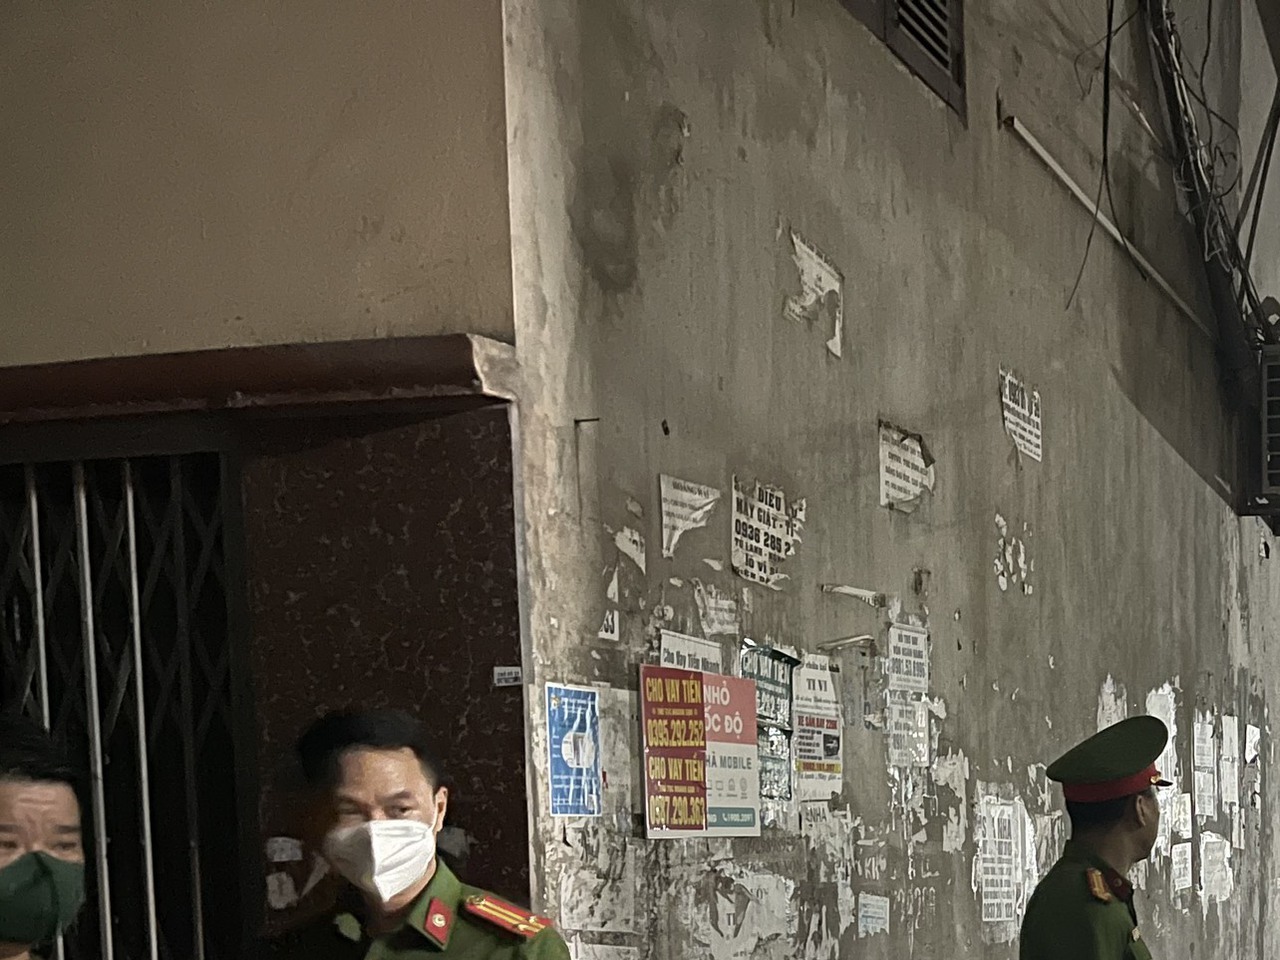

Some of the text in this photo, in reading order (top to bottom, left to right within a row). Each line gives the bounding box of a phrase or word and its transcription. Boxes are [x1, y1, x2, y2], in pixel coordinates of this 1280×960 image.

[735, 518, 760, 544] 0936
[646, 677, 664, 702] CHO
[665, 679, 680, 703] VAY
[704, 680, 730, 705] NHỎ
[724, 711, 743, 739] ĐỘ
[649, 756, 666, 780] CHO
[667, 757, 682, 780] VAY
[720, 756, 752, 769] MOBILE
